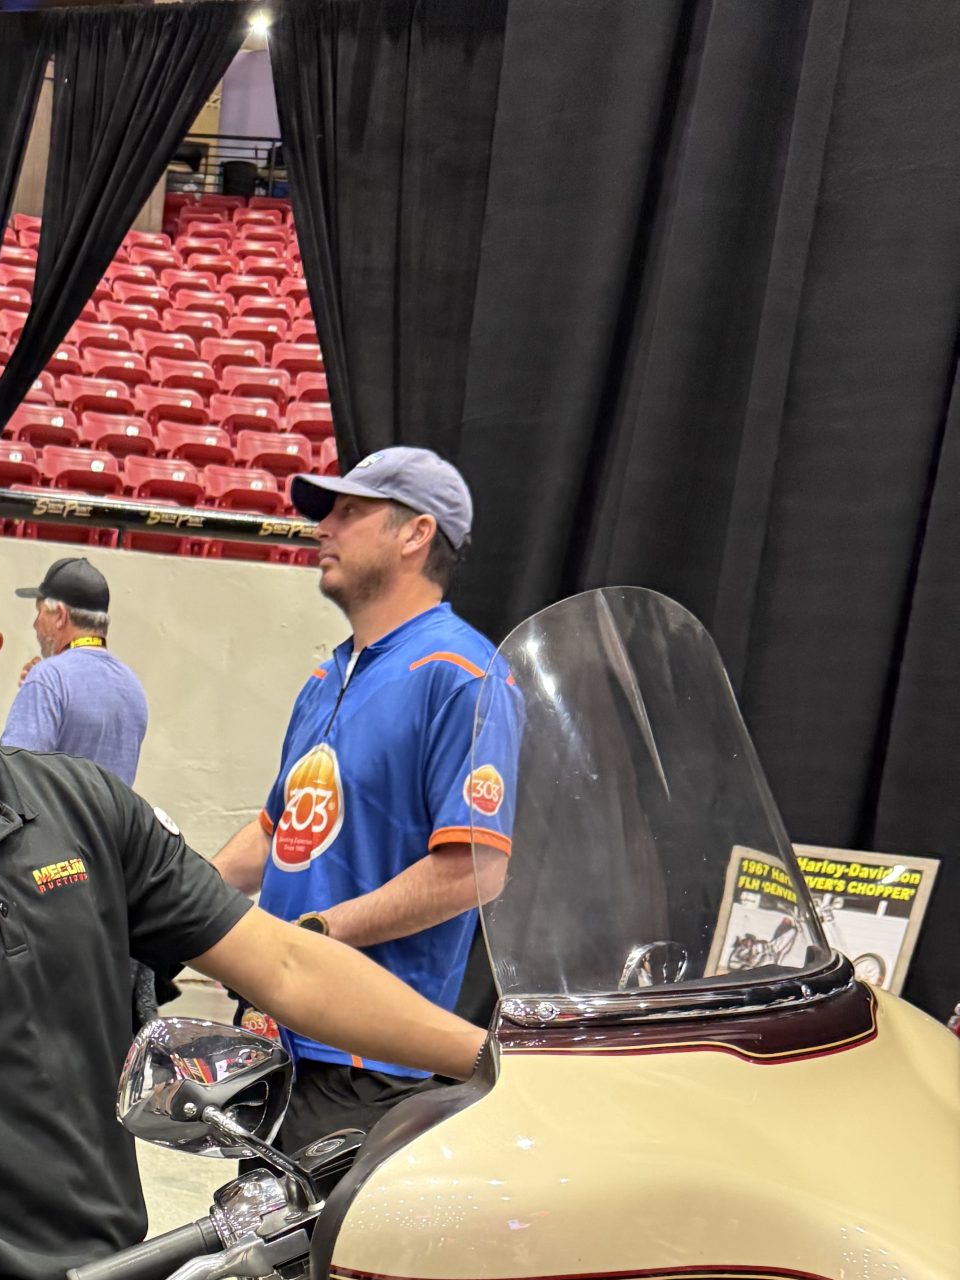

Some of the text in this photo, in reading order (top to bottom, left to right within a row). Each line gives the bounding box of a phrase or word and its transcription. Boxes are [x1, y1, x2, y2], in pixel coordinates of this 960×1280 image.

[278, 786, 333, 833] 303
[32, 858, 86, 885] MECUM
[796, 856, 921, 885] Harley-Davidon
